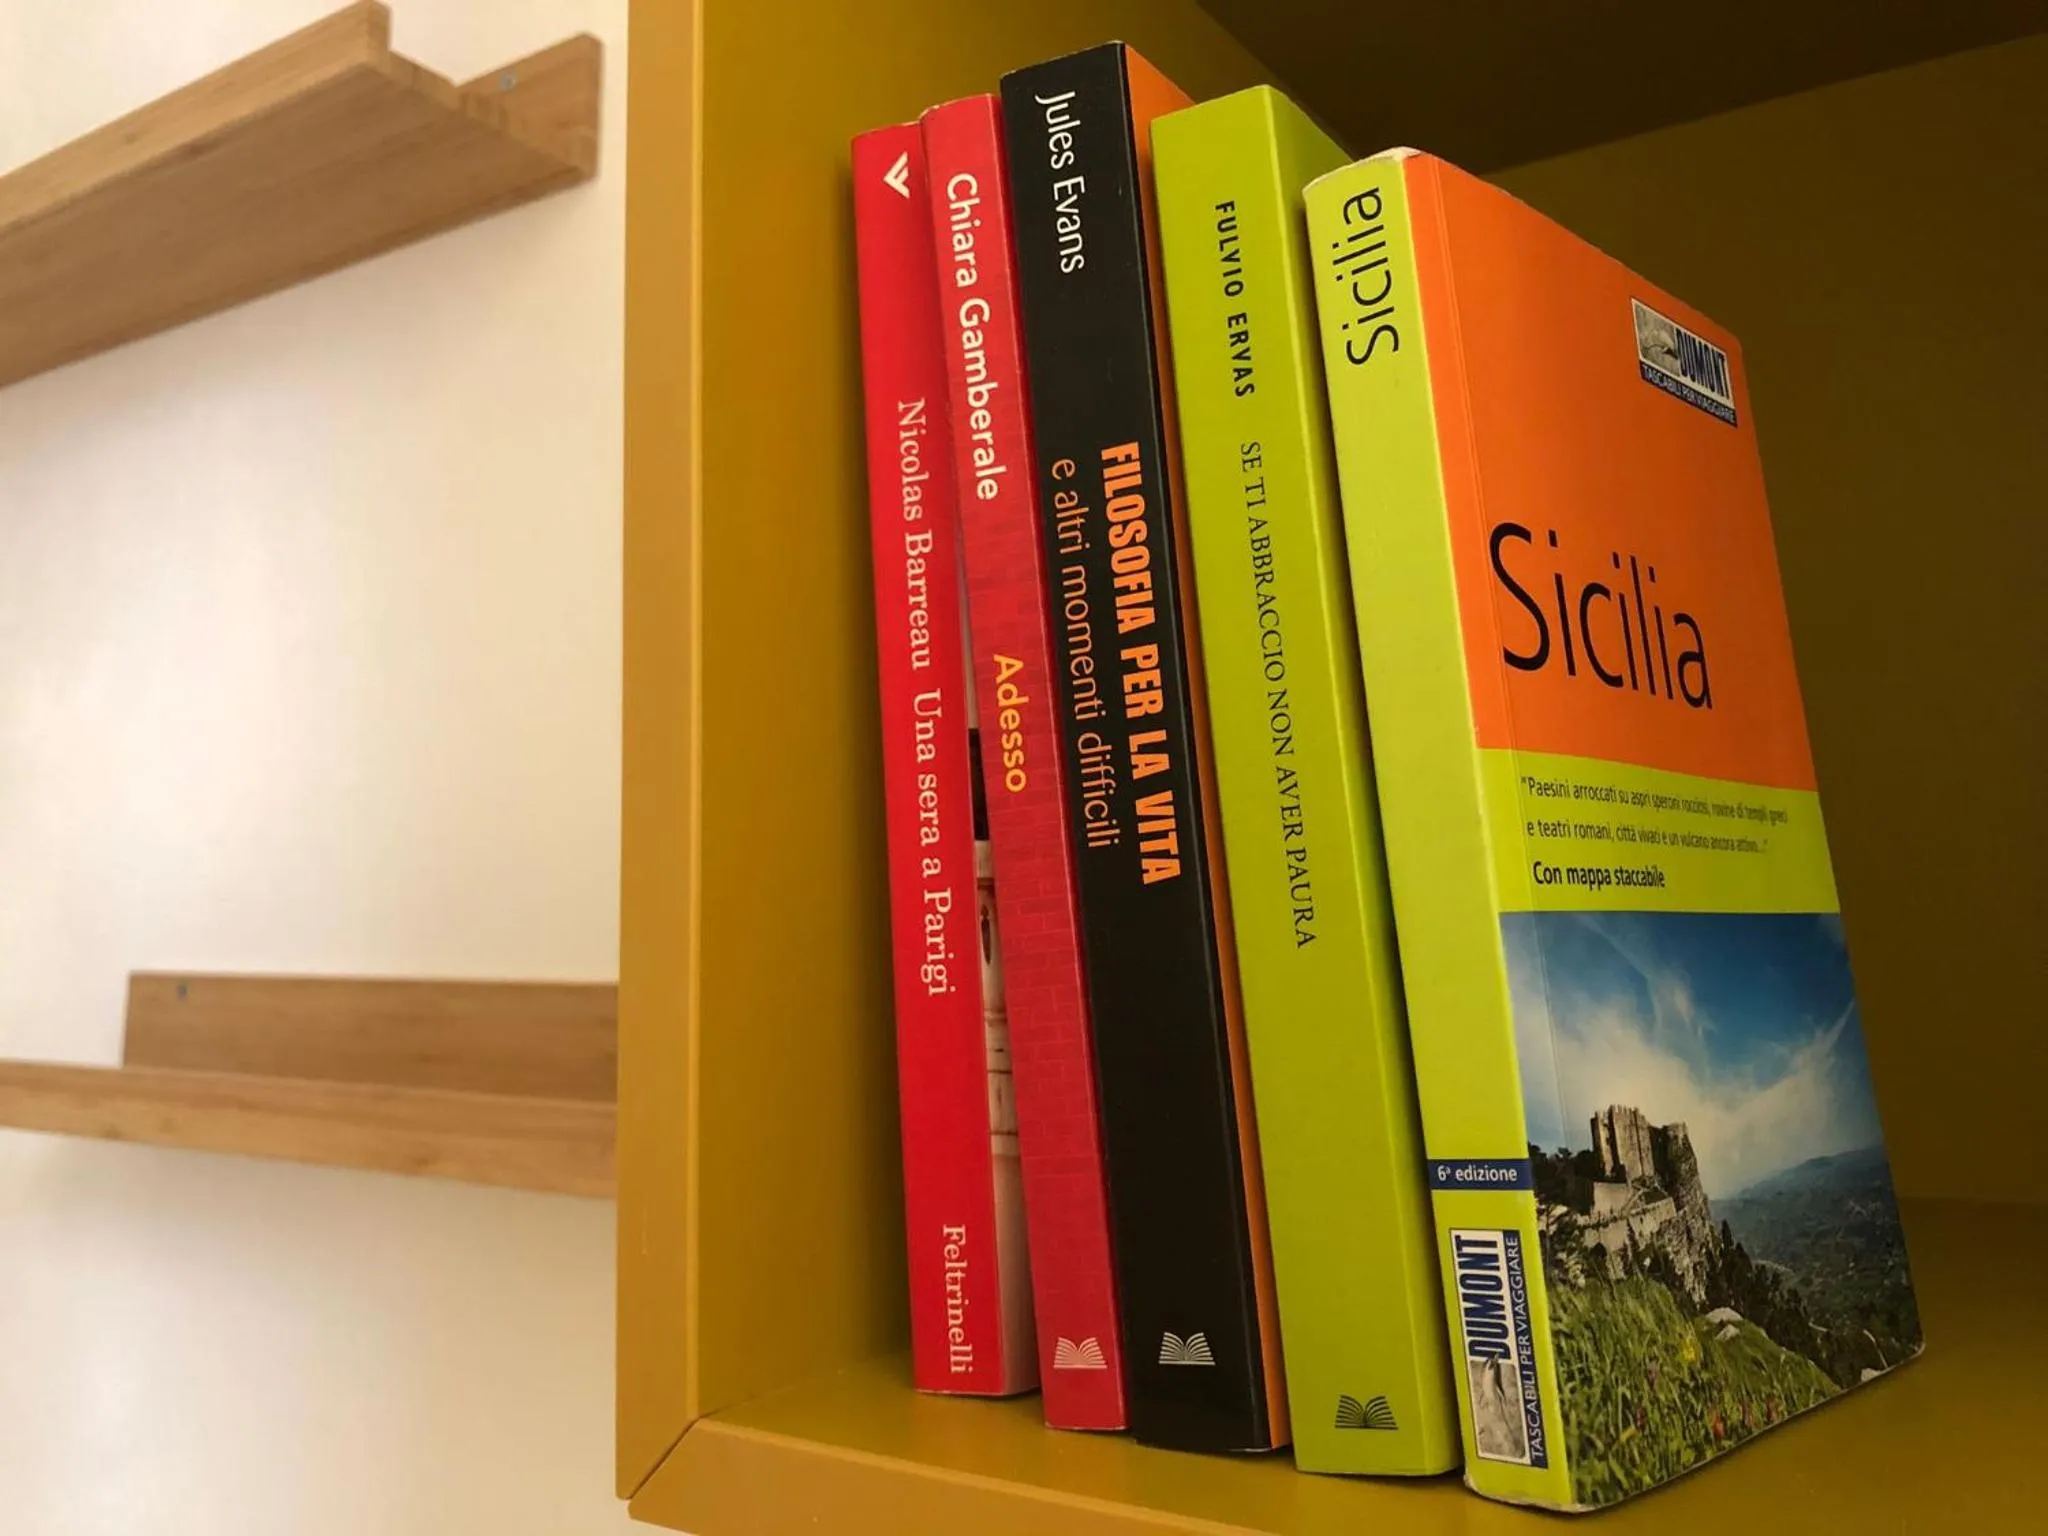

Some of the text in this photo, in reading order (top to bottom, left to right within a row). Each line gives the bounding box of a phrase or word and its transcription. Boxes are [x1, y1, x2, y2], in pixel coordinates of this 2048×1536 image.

[1034, 91, 1085, 273] Jules Evans
[946, 172, 1007, 500] Chiara Gamberale
[1215, 200, 1254, 397] FULVIO ERVAS
[1332, 186, 1399, 366] Sicilia
[898, 397, 957, 996] Nicolas Barreau Una sera a Parigi
[1052, 458, 1121, 848] e altri momenti difficili
[1101, 440, 1181, 885] FILOSOFIA PER LA VITA
[1240, 441, 1317, 949] SE TI ABBRACCIO NON AVER PAURA
[1489, 521, 1713, 709] Sicilia
[993, 653, 1029, 792] Adesso
[1573, 785, 1617, 803] arroccati
[1527, 821, 1535, 837] e
[1537, 820, 1571, 838] teatri
[1573, 822, 1615, 843] romani,
[1616, 824, 1637, 842] città
[1532, 860, 1666, 891] Con mappa staccabile
[1455, 1163, 1518, 1182] edizione
[942, 1223, 973, 1374] Feltrinelli
[1455, 1235, 1512, 1361] DUMONT
[1507, 1236, 1545, 1459] TASCABILI PER VIAGGIARE
